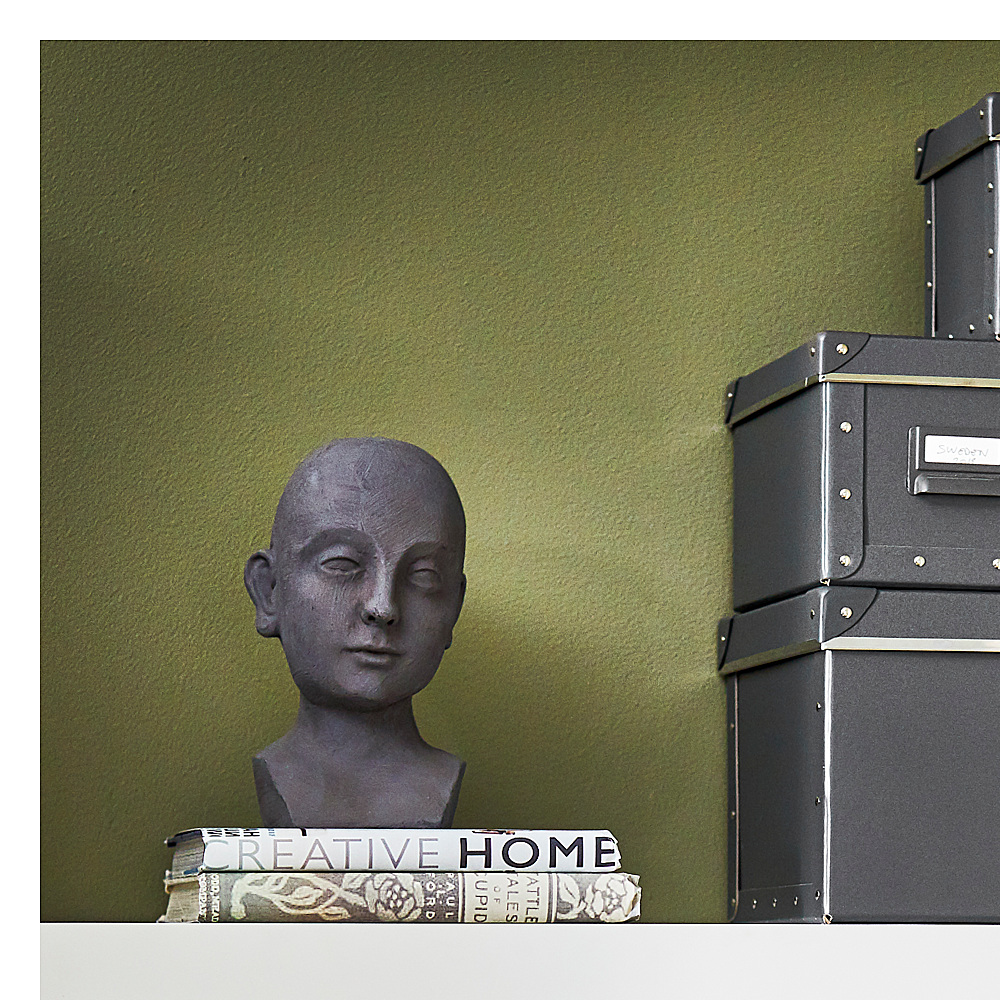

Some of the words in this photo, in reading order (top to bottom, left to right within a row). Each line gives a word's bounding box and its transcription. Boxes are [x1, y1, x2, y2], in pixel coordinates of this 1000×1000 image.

[936, 444, 989, 457] SWEDEN
[204, 837, 439, 870] CREATIVE
[459, 836, 617, 869] HOME
